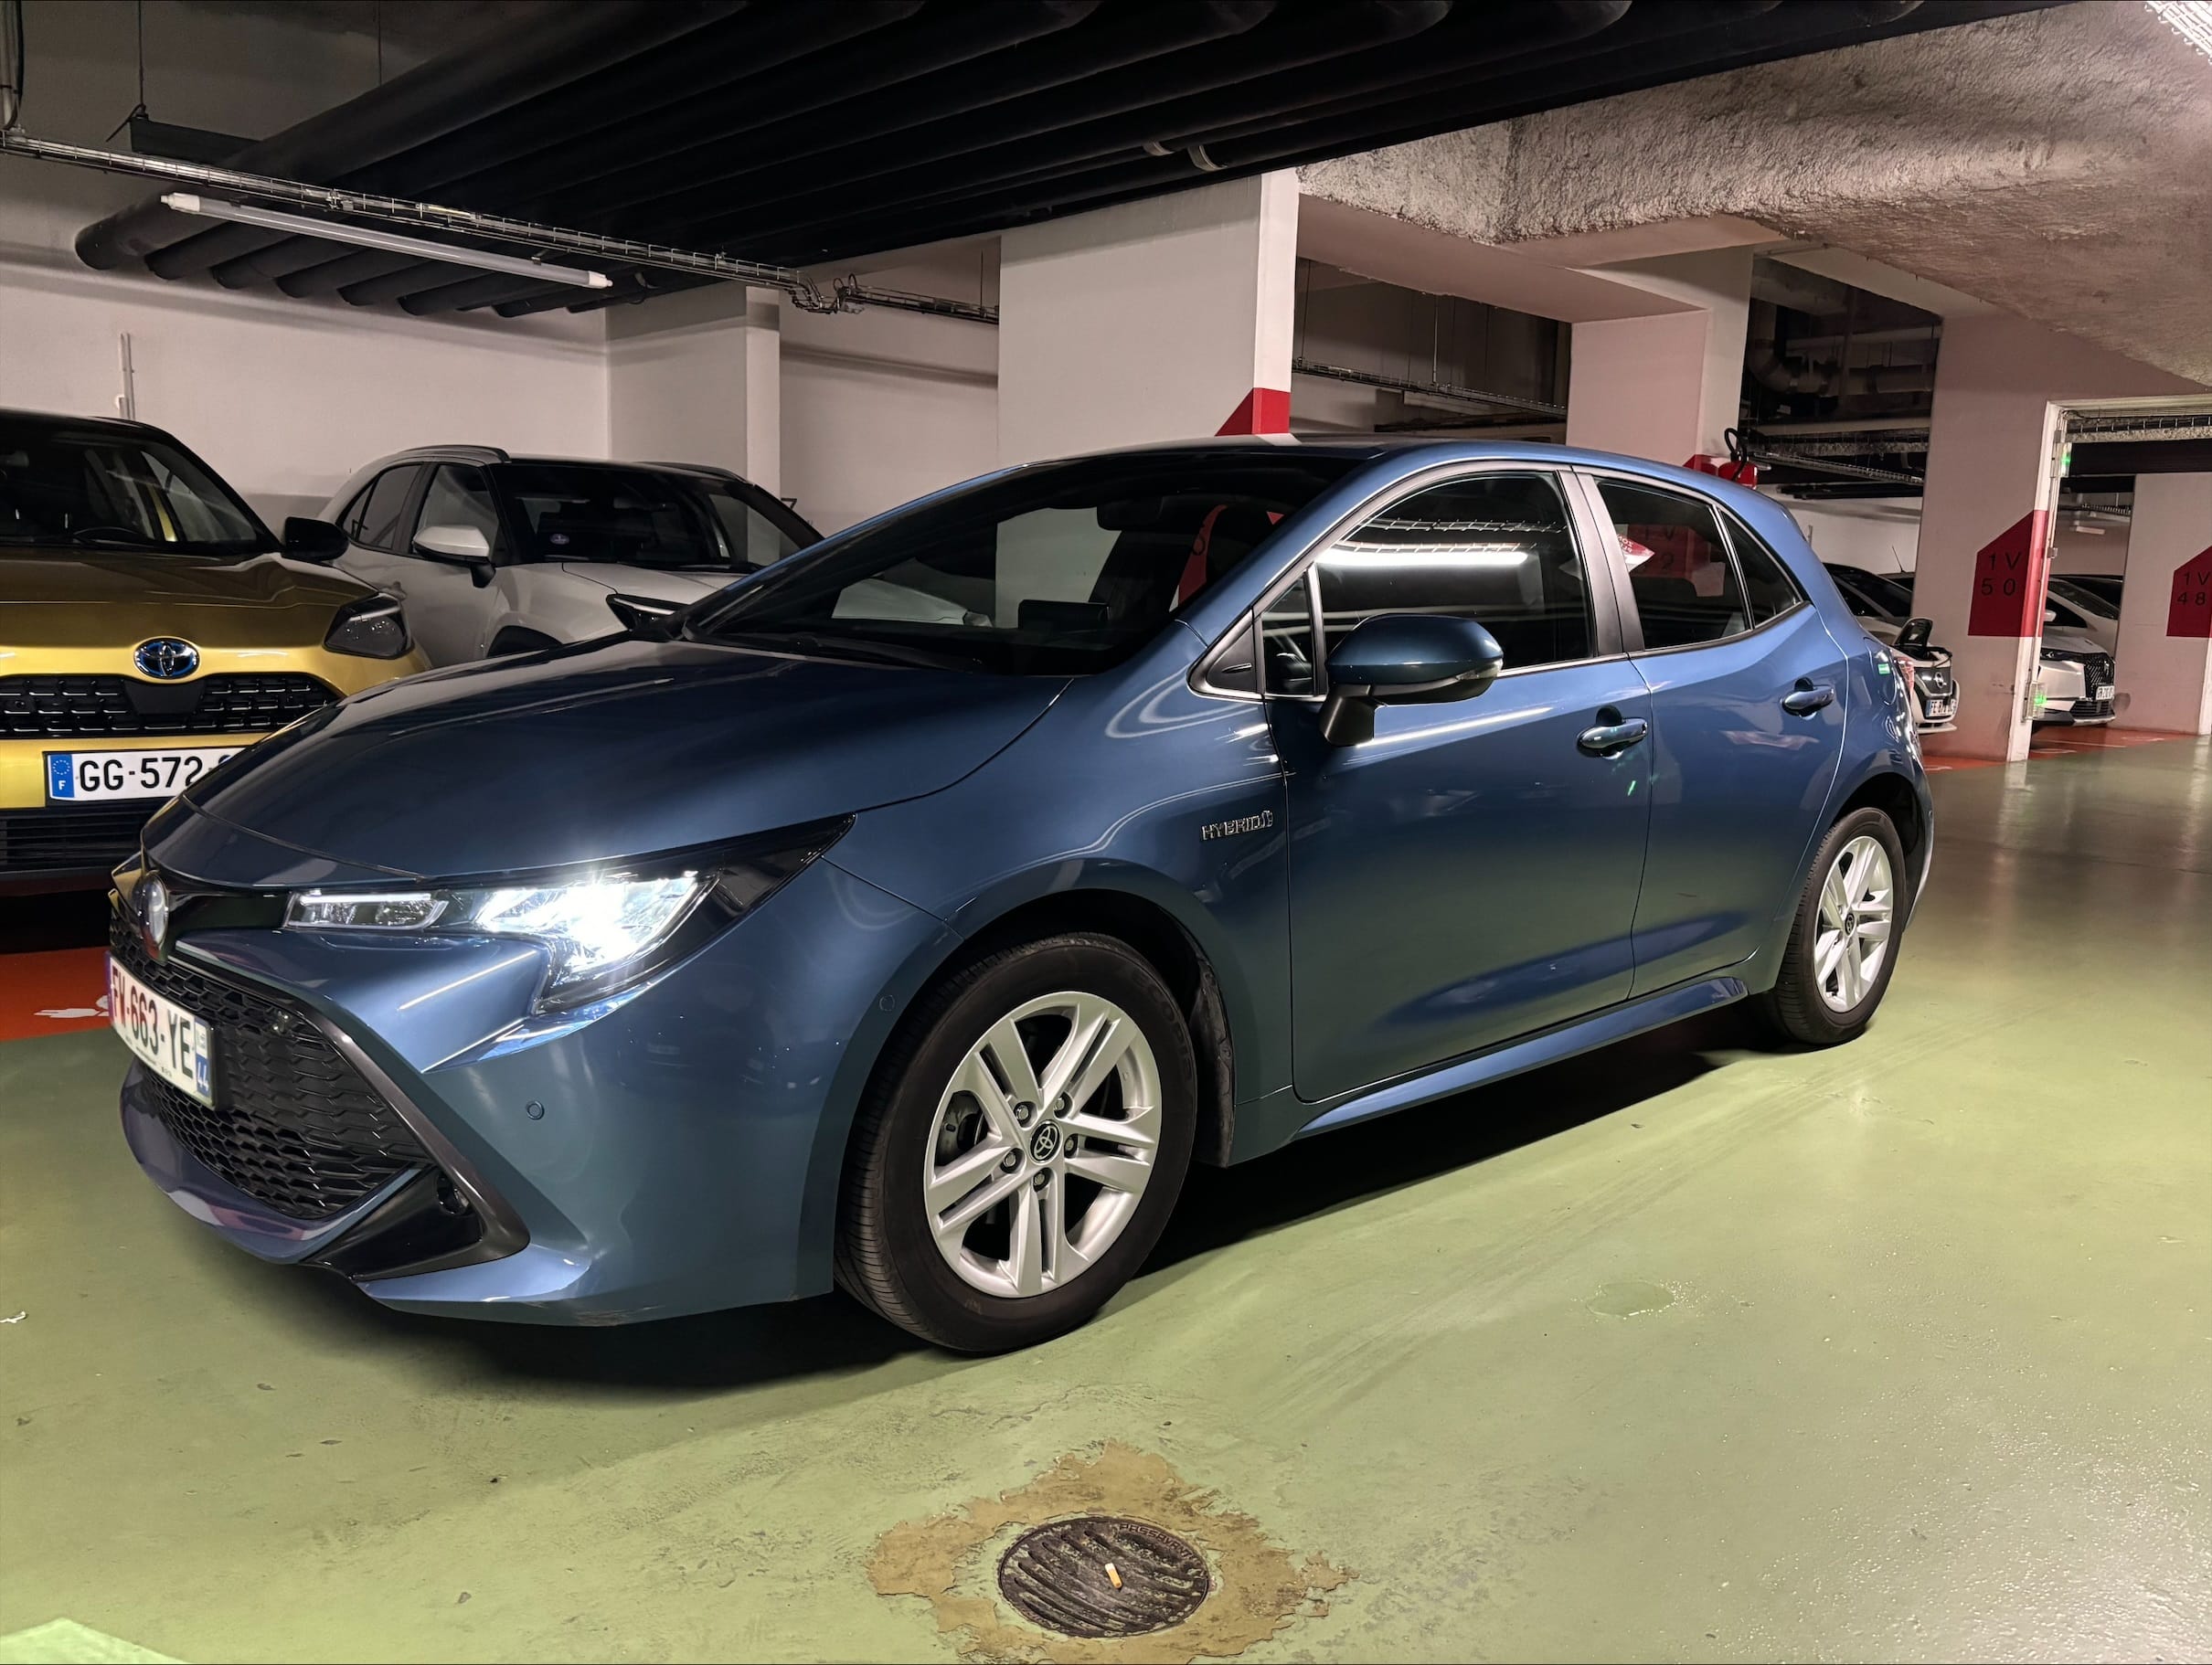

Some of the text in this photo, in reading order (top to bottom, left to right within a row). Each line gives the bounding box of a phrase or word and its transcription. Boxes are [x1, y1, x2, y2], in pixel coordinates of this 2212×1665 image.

[1981, 578, 2016, 597] 50
[2176, 591, 2207, 606] 48
[58, 779, 67, 791] F
[1201, 814, 1261, 841] HYBRID
